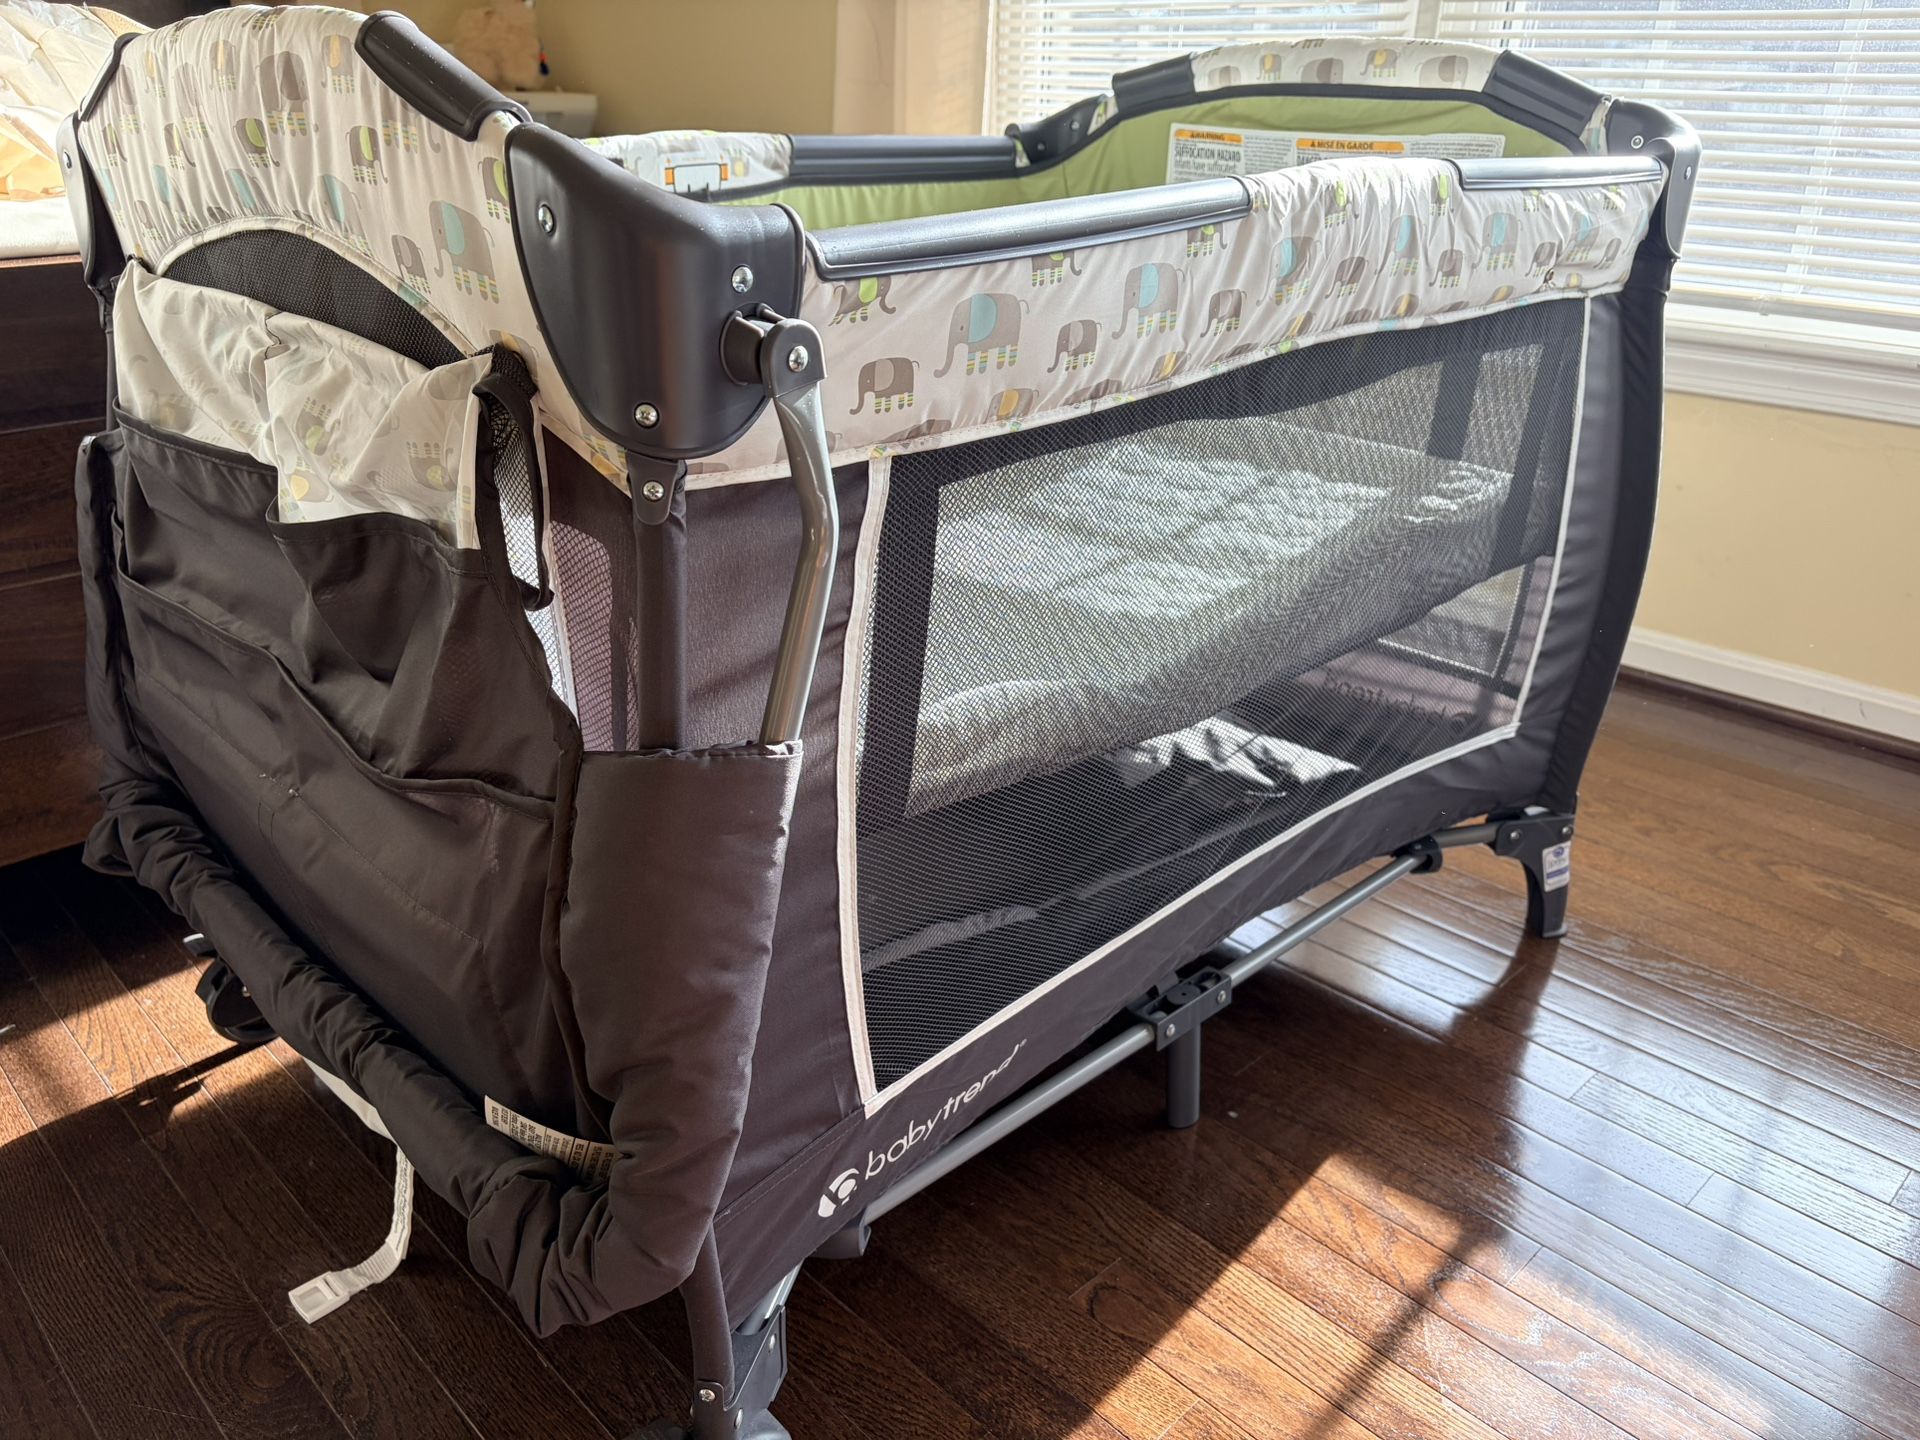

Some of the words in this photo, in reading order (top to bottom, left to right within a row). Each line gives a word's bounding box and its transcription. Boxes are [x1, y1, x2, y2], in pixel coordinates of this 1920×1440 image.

[1174, 145, 1215, 160] SUFFOCATION
[1217, 149, 1241, 163] HAZARD
[1317, 141, 1334, 149] MISE
[1336, 142, 1345, 150] EN
[1347, 142, 1374, 150] GARDE
[864, 1042, 1020, 1181] babytrend
